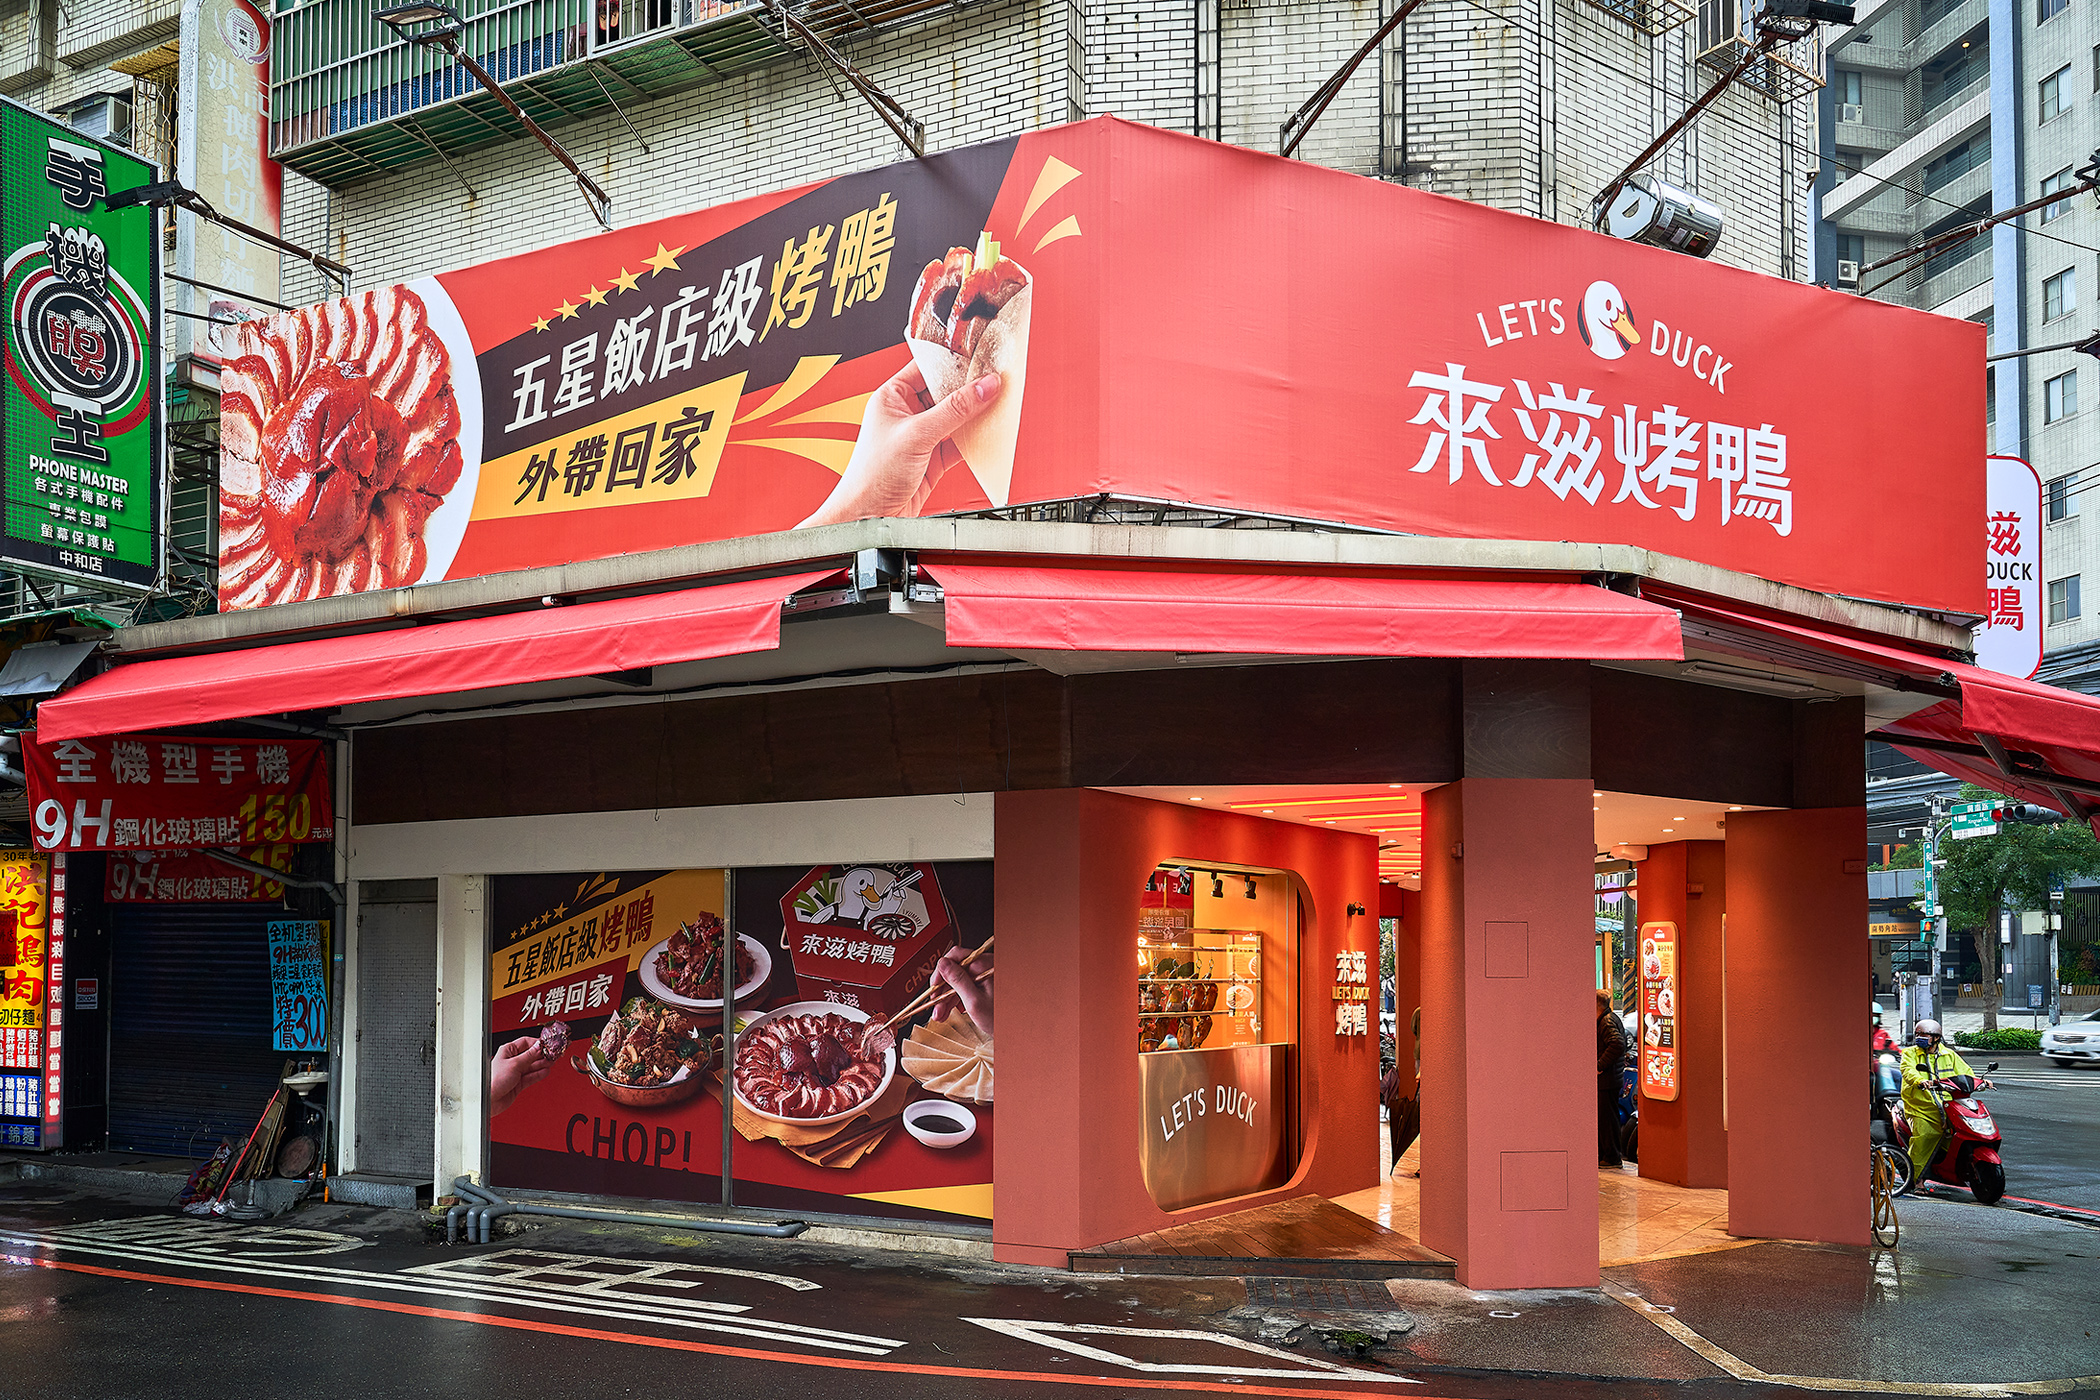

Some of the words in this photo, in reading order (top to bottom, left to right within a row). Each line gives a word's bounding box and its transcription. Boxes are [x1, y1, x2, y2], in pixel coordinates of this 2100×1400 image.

[45, 137, 108, 462] 手機膜王
[504, 193, 898, 434] 五星飯店級烤鴨
[1476, 297, 1566, 348] LET'S
[1650, 319, 1734, 395] DUCK
[514, 407, 715, 506] 外帶回家
[1406, 362, 1793, 538] 來滋烤鴨
[29, 454, 78, 482] PHONE
[80, 467, 129, 495] MASTER
[34, 476, 124, 511] 各式手機配件
[40, 522, 115, 552] 螢幕保護貼
[59, 550, 103, 573] 中和店
[1987, 585, 2024, 631] 鴨
[52, 740, 290, 785] 全機型手機
[35, 798, 113, 849] 9H
[113, 816, 241, 846] 鋼化玻璃貼
[240, 793, 311, 842] 150
[111, 863, 160, 899] 9H
[157, 876, 249, 900] 鋼化玻璃貼
[503, 889, 655, 989] 五星飯店級烤鴨
[799, 933, 897, 968] 來滋烤鴨
[1335, 949, 1367, 984] 來滋
[519, 973, 614, 1023] 外帶回家
[823, 989, 860, 1008] 來滋
[1352, 986, 1371, 1000] DUCK
[292, 994, 329, 1049] 300
[1335, 1002, 1368, 1036] 烤鴨
[1160, 1086, 1207, 1142] LET'S
[1215, 1084, 1258, 1128] DUCK
[566, 1113, 691, 1172] CHOP!
